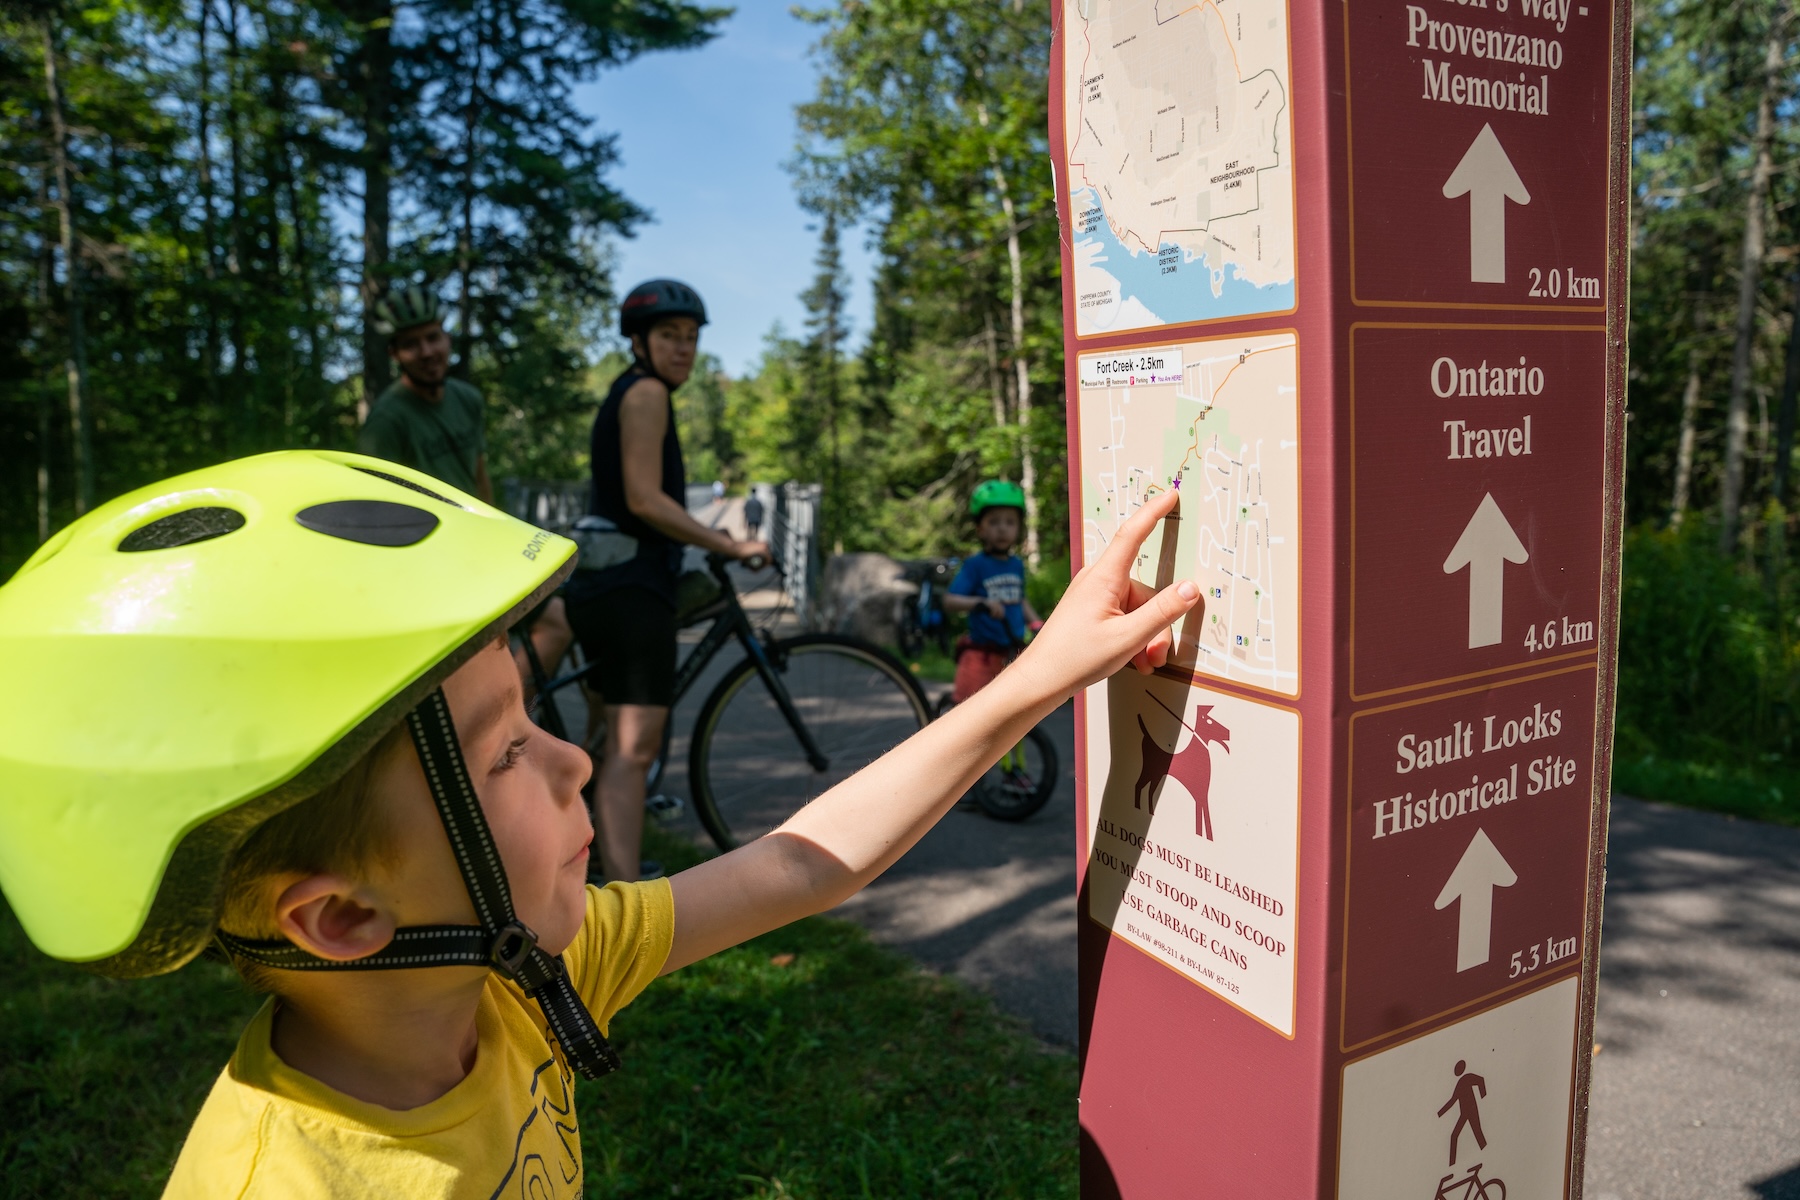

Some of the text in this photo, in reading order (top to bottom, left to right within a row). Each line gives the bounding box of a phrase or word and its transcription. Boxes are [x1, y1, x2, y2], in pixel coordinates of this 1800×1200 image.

[1406, 5, 1562, 69] Provenzano
[1084, 73, 1104, 87] CARMEN'S
[1422, 58, 1548, 115] Memorial
[1210, 166, 1255, 184] NEIGHBOURHOOD
[1226, 160, 1239, 170] EAST
[1078, 215, 1103, 227] WATERFRONT
[1079, 207, 1102, 219] DOWNTOWN
[1159, 247, 1179, 257] HISTORIC
[1159, 256, 1179, 266] DISTRICT
[1528, 267, 1600, 298] 2.0 km
[1096, 361, 1111, 374] Fort
[1112, 359, 1134, 373] Creek
[1140, 357, 1164, 370] 2.5km
[1431, 356, 1544, 398] Ontario
[1443, 414, 1532, 459] Travel
[1524, 616, 1593, 653] 4.6 km
[1396, 702, 1562, 774] Sault Locks
[1372, 755, 1576, 840] Historical Site
[1097, 817, 1284, 917] ALL DOGS MUST BE LEASHED
[1095, 848, 1286, 957] YOU MUST STOOP AND SCOOP
[1121, 889, 1247, 970] USE GARBAGE CANS
[1127, 923, 1151, 943] BY-LAW
[1187, 957, 1215, 980] BY-LAW
[1216, 975, 1240, 994] 87-125
[1508, 936, 1577, 979] 5.3 km
